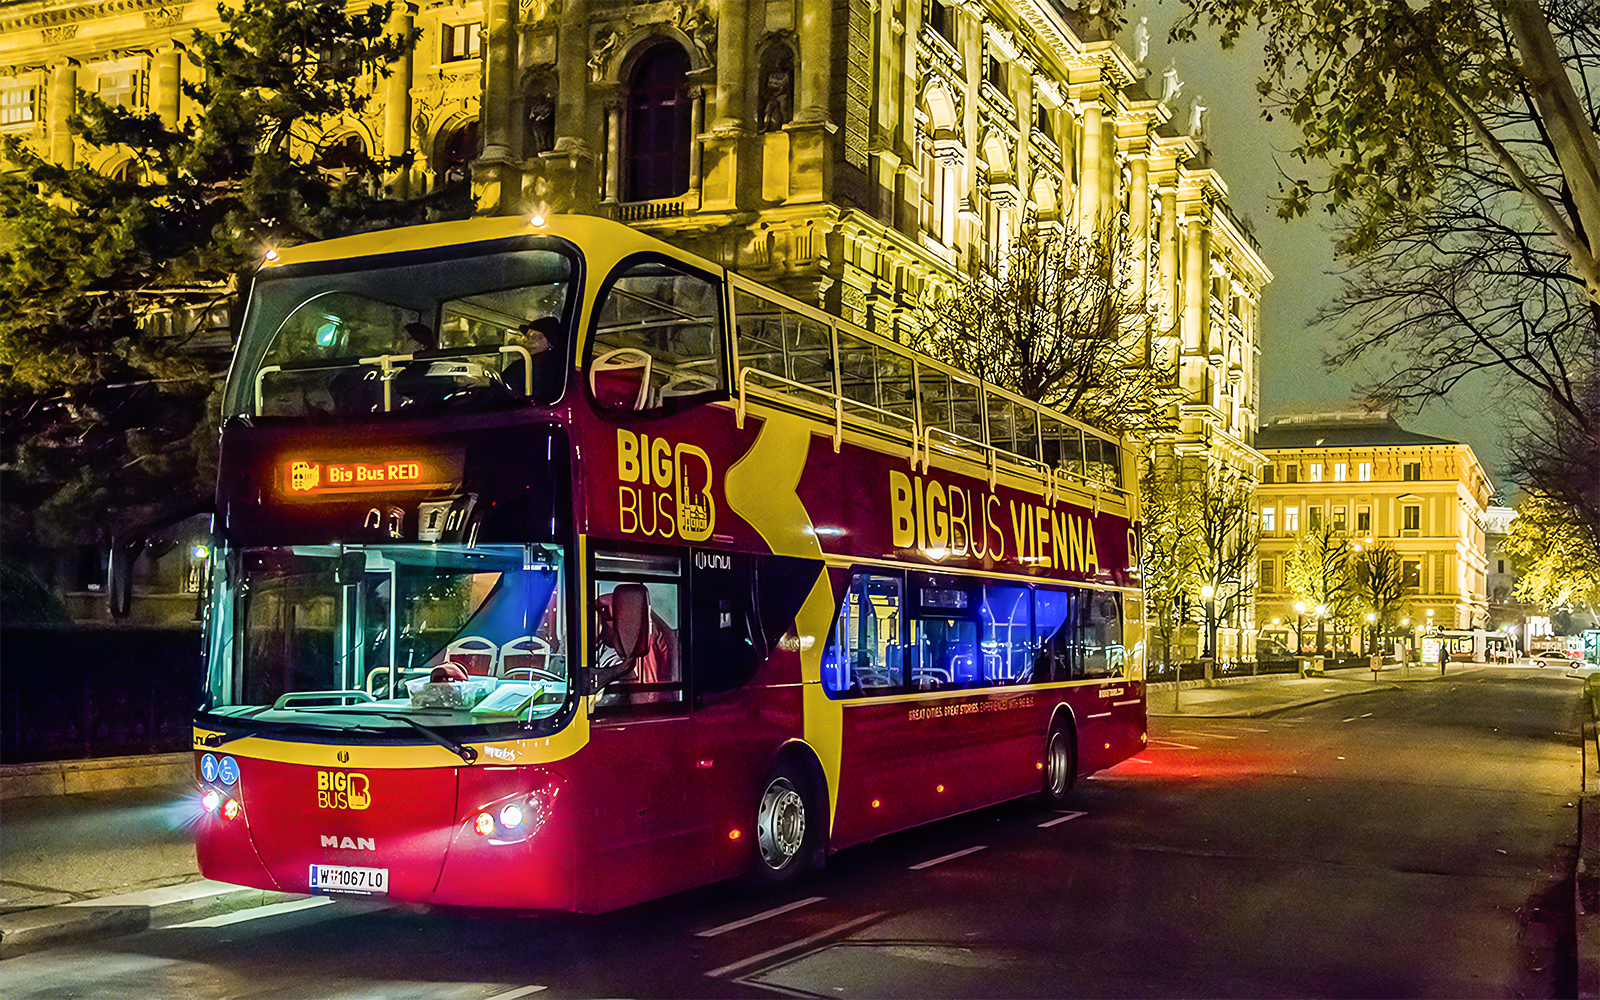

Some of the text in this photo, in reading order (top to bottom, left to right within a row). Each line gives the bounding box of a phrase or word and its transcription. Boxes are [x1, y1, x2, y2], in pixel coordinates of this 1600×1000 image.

[617, 428, 673, 488] BIG
[330, 463, 419, 482] Big Bus RED
[619, 486, 675, 538] BUS
[1010, 499, 1099, 573] VIENNA
[317, 770, 347, 791] BIG
[318, 790, 348, 809] BUS
[320, 834, 376, 851] MAN
[320, 869, 329, 884] W
[338, 870, 366, 886] 1067
